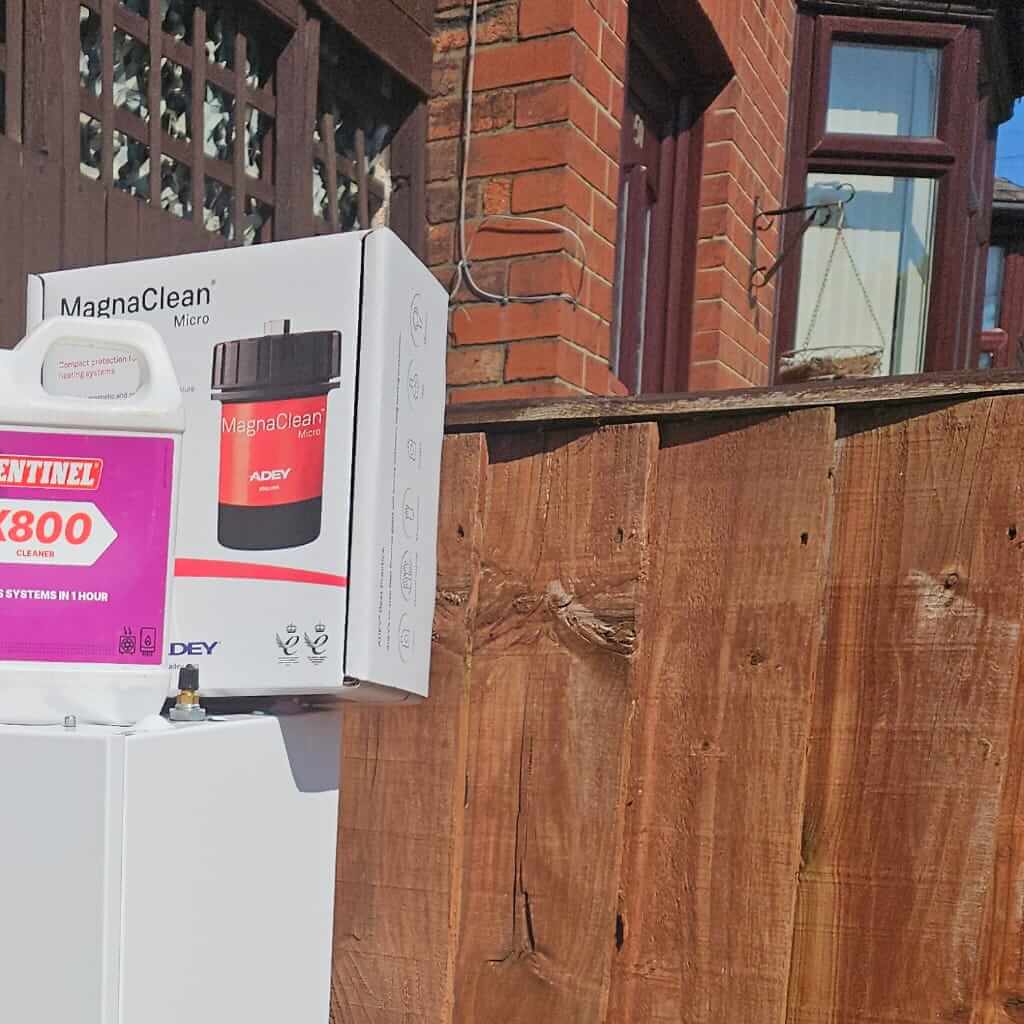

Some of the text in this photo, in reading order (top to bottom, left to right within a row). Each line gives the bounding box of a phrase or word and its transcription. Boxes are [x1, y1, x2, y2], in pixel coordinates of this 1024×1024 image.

[60, 286, 210, 318] MagnaClean
[174, 314, 210, 328] Micro
[222, 411, 322, 437] MagnaClean
[298, 429, 321, 439] Micro
[249, 468, 291, 481] ADEY
[16, 549, 55, 558] CLEANER
[5, 588, 57, 600] SYSTEMS
[58, 590, 70, 601] IN
[71, 590, 76, 601] 1
[78, 591, 108, 602] HOUR
[168, 641, 218, 656] DEY
